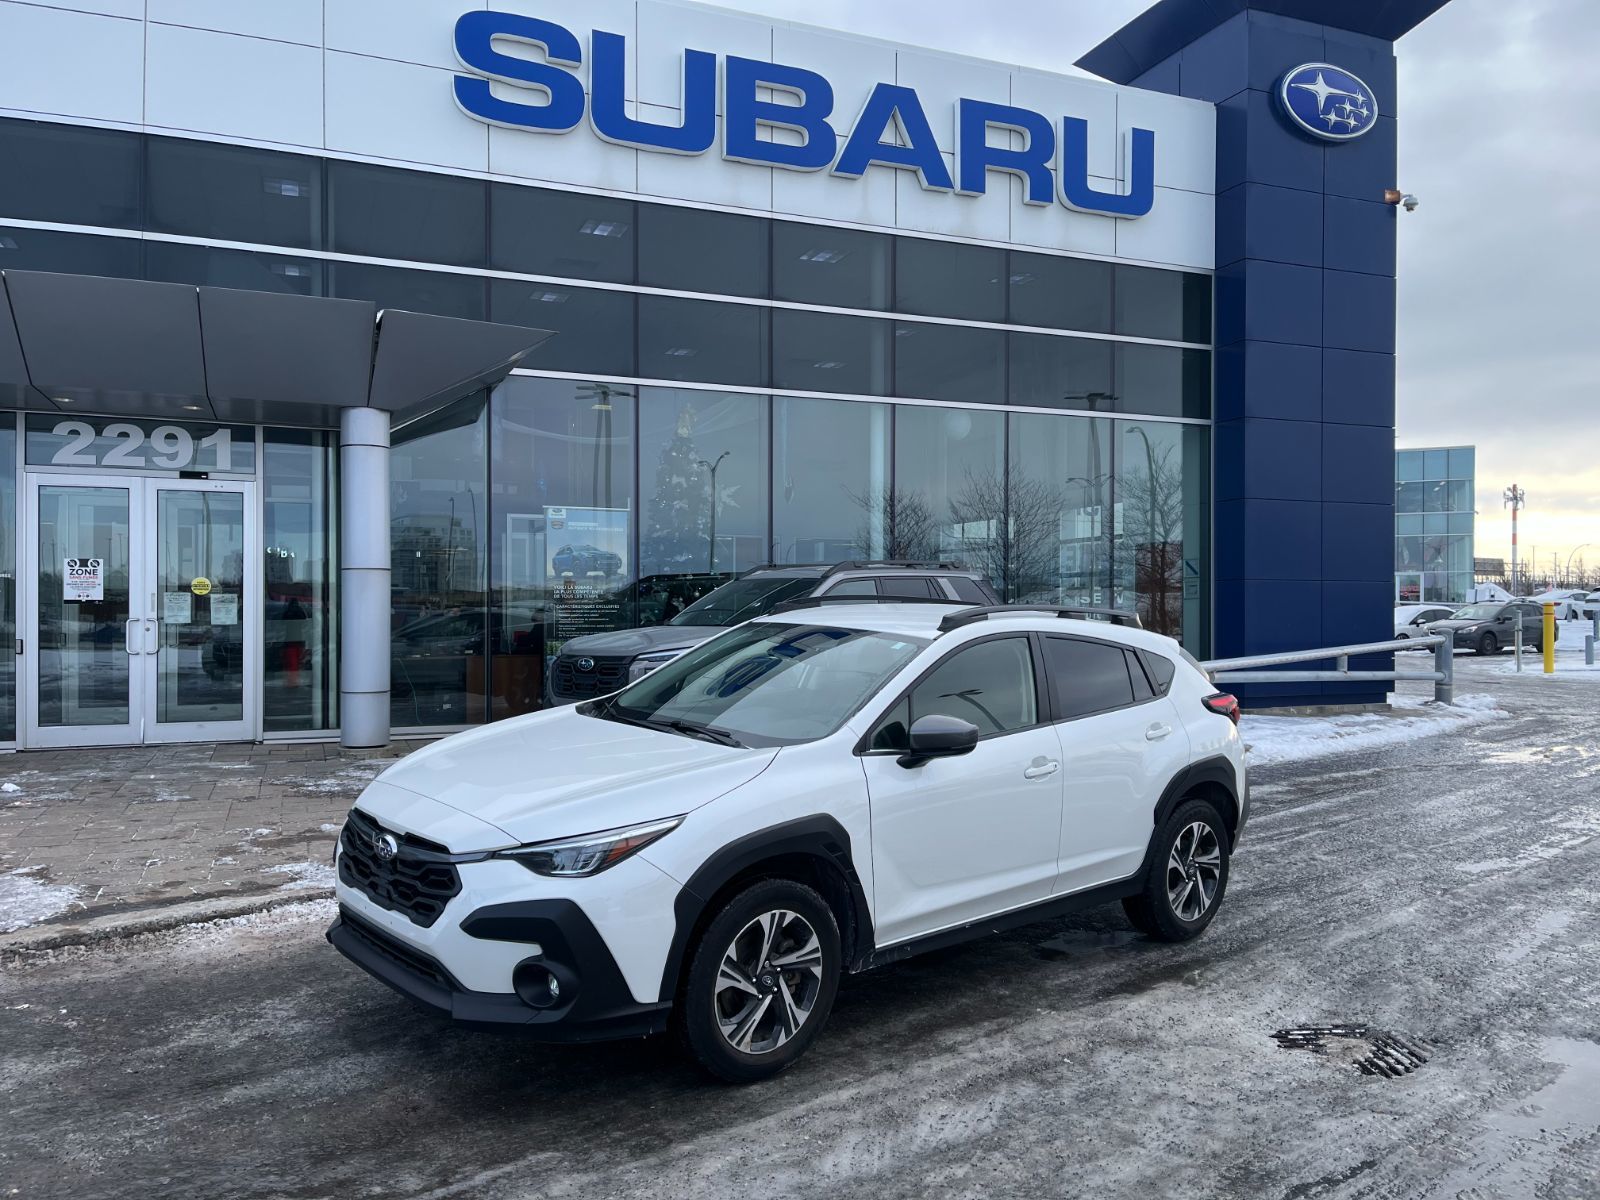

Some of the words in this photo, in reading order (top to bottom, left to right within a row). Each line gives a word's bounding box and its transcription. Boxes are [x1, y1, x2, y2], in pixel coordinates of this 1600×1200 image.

[453, 9, 1155, 220] SUBARU
[51, 420, 232, 471] 2291
[69, 568, 98, 576] ZONE
